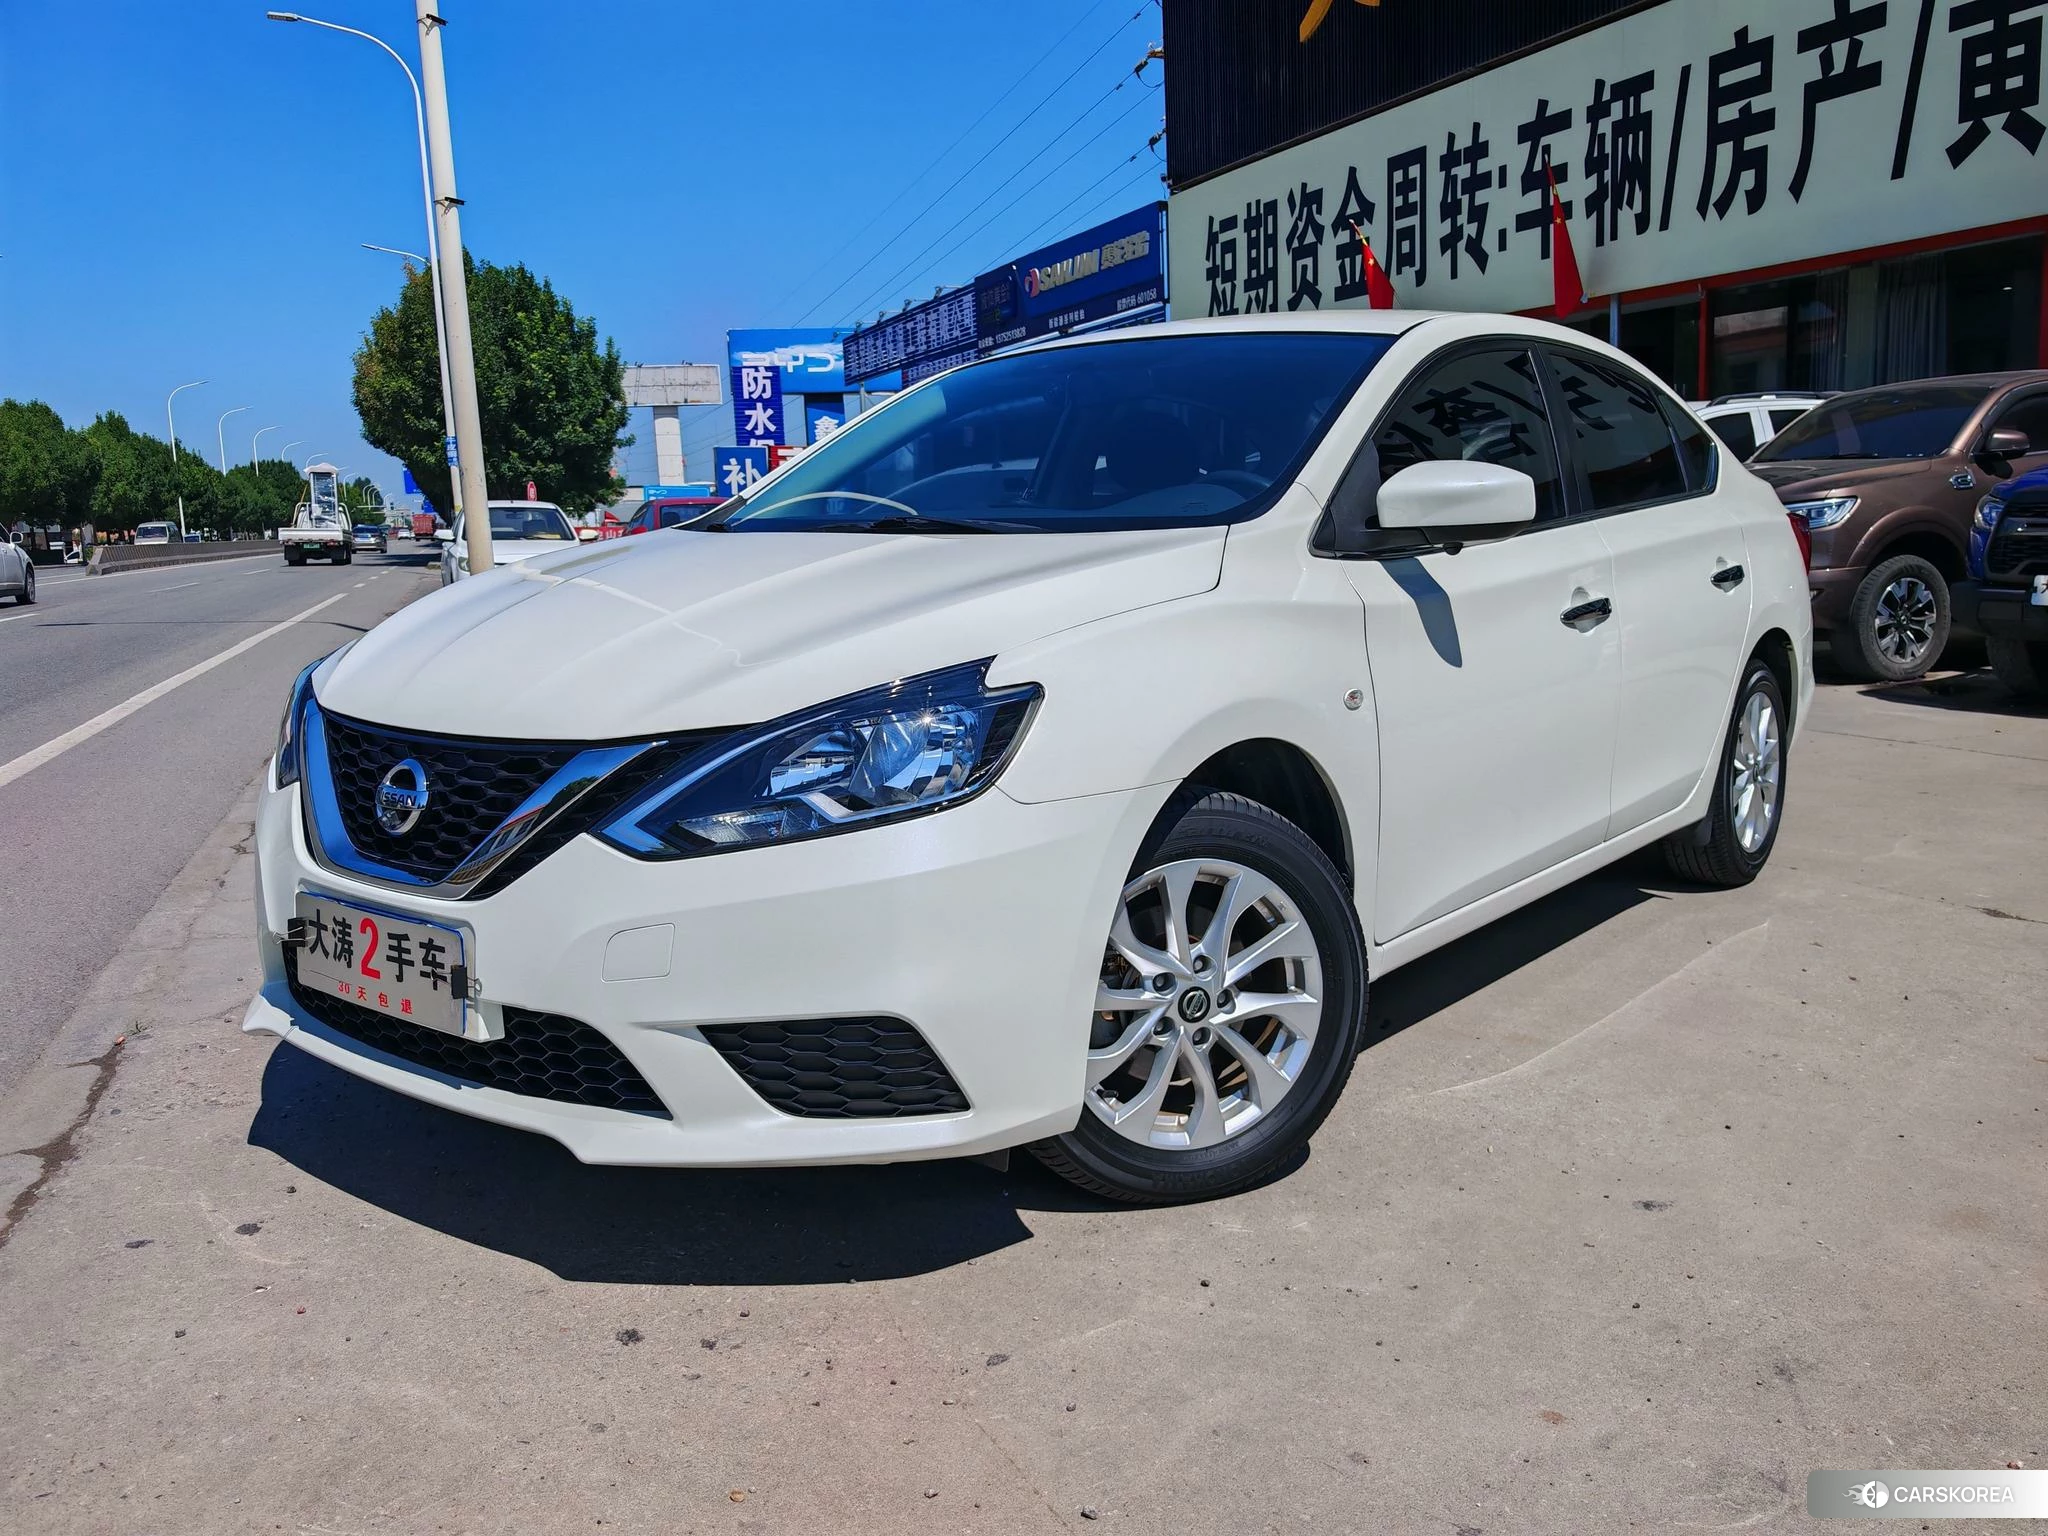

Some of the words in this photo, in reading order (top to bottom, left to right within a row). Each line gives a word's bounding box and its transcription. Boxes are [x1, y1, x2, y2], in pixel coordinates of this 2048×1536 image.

[1136, 288, 1158, 304] 601058
[309, 909, 447, 991] 大涛2手车
